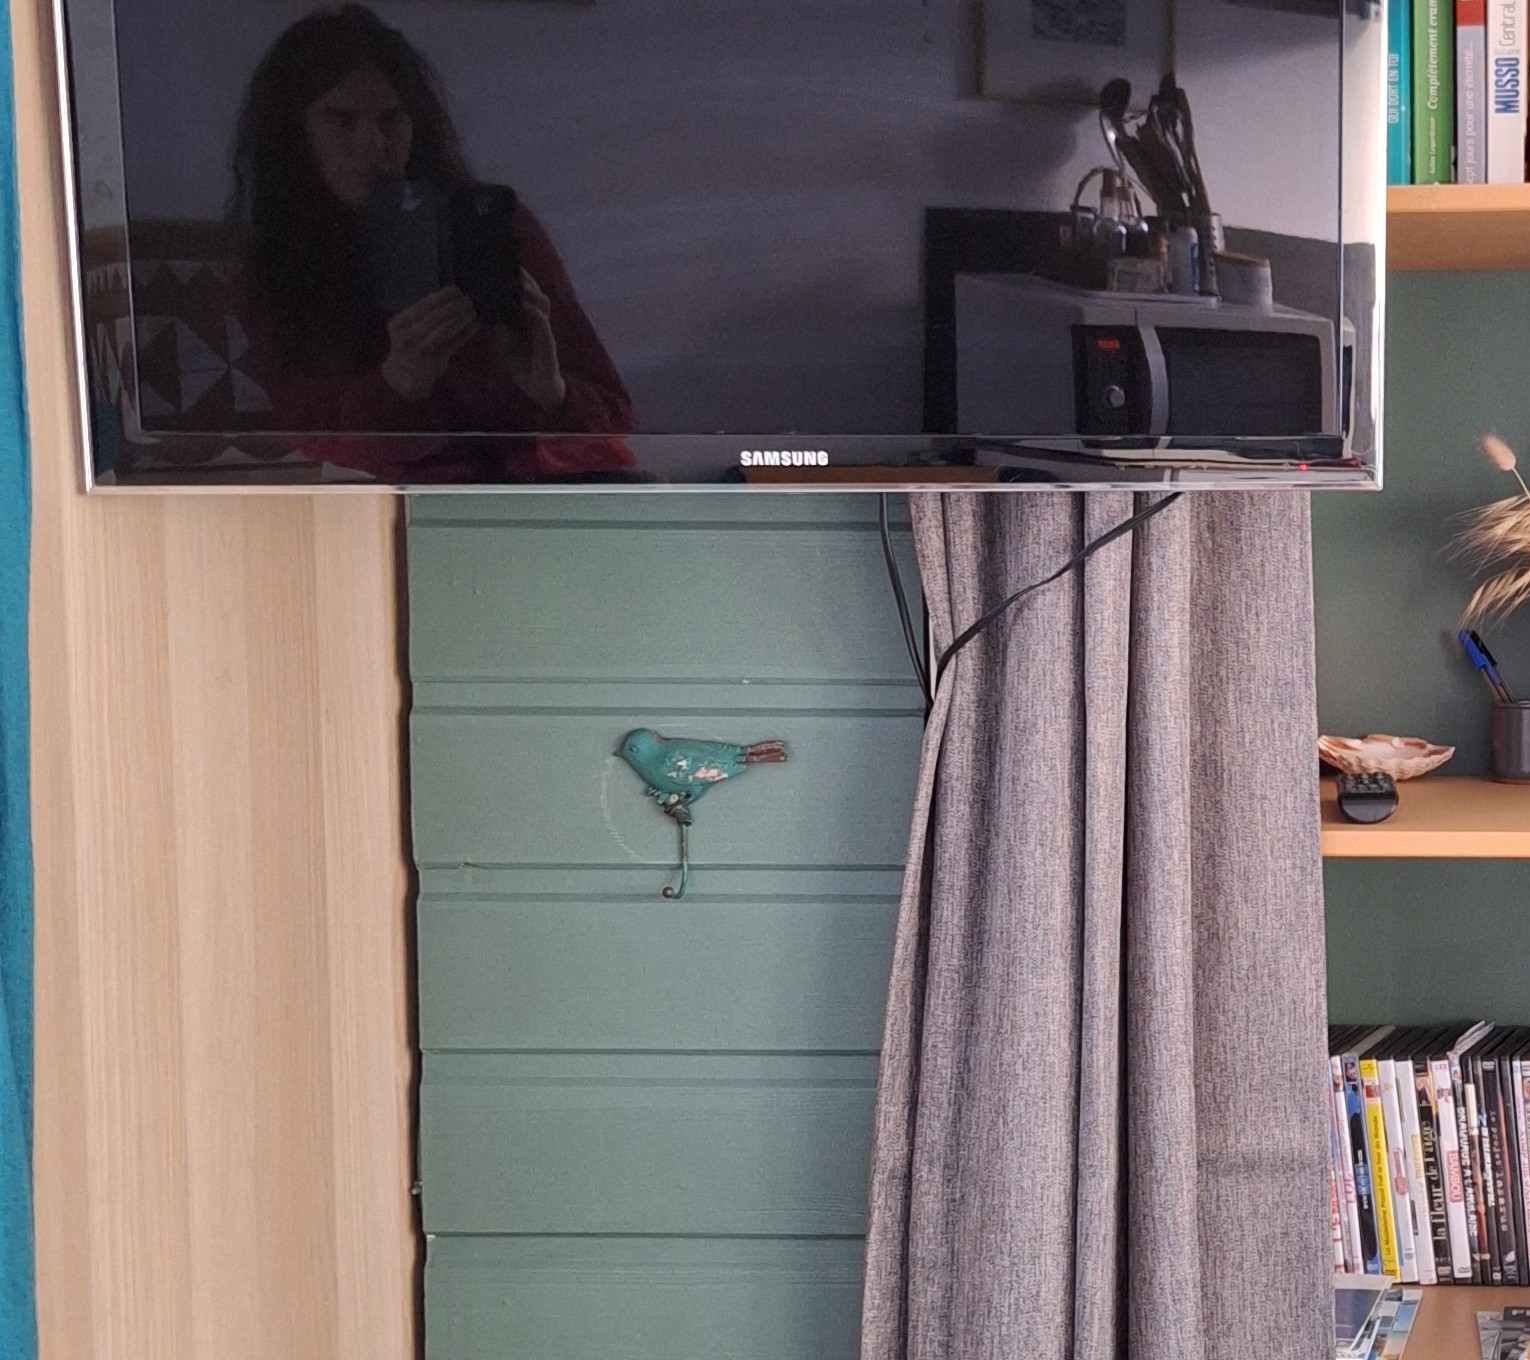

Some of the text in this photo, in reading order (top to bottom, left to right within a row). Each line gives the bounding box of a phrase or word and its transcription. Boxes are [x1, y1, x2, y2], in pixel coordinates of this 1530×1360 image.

[1494, 2, 1516, 47] Central
[1426, 28, 1440, 110] Complètement
[1494, 57, 1520, 114] MUSSO
[1464, 89, 1474, 110] une
[1464, 112, 1476, 137] pour
[1463, 139, 1476, 164] jours
[739, 450, 829, 467] SAMSUNG
[1426, 1164, 1439, 1181] de
[1447, 1151, 1462, 1201] BAMBOU
[1430, 1186, 1445, 1223] fleur
[1433, 1228, 1447, 1241] la
